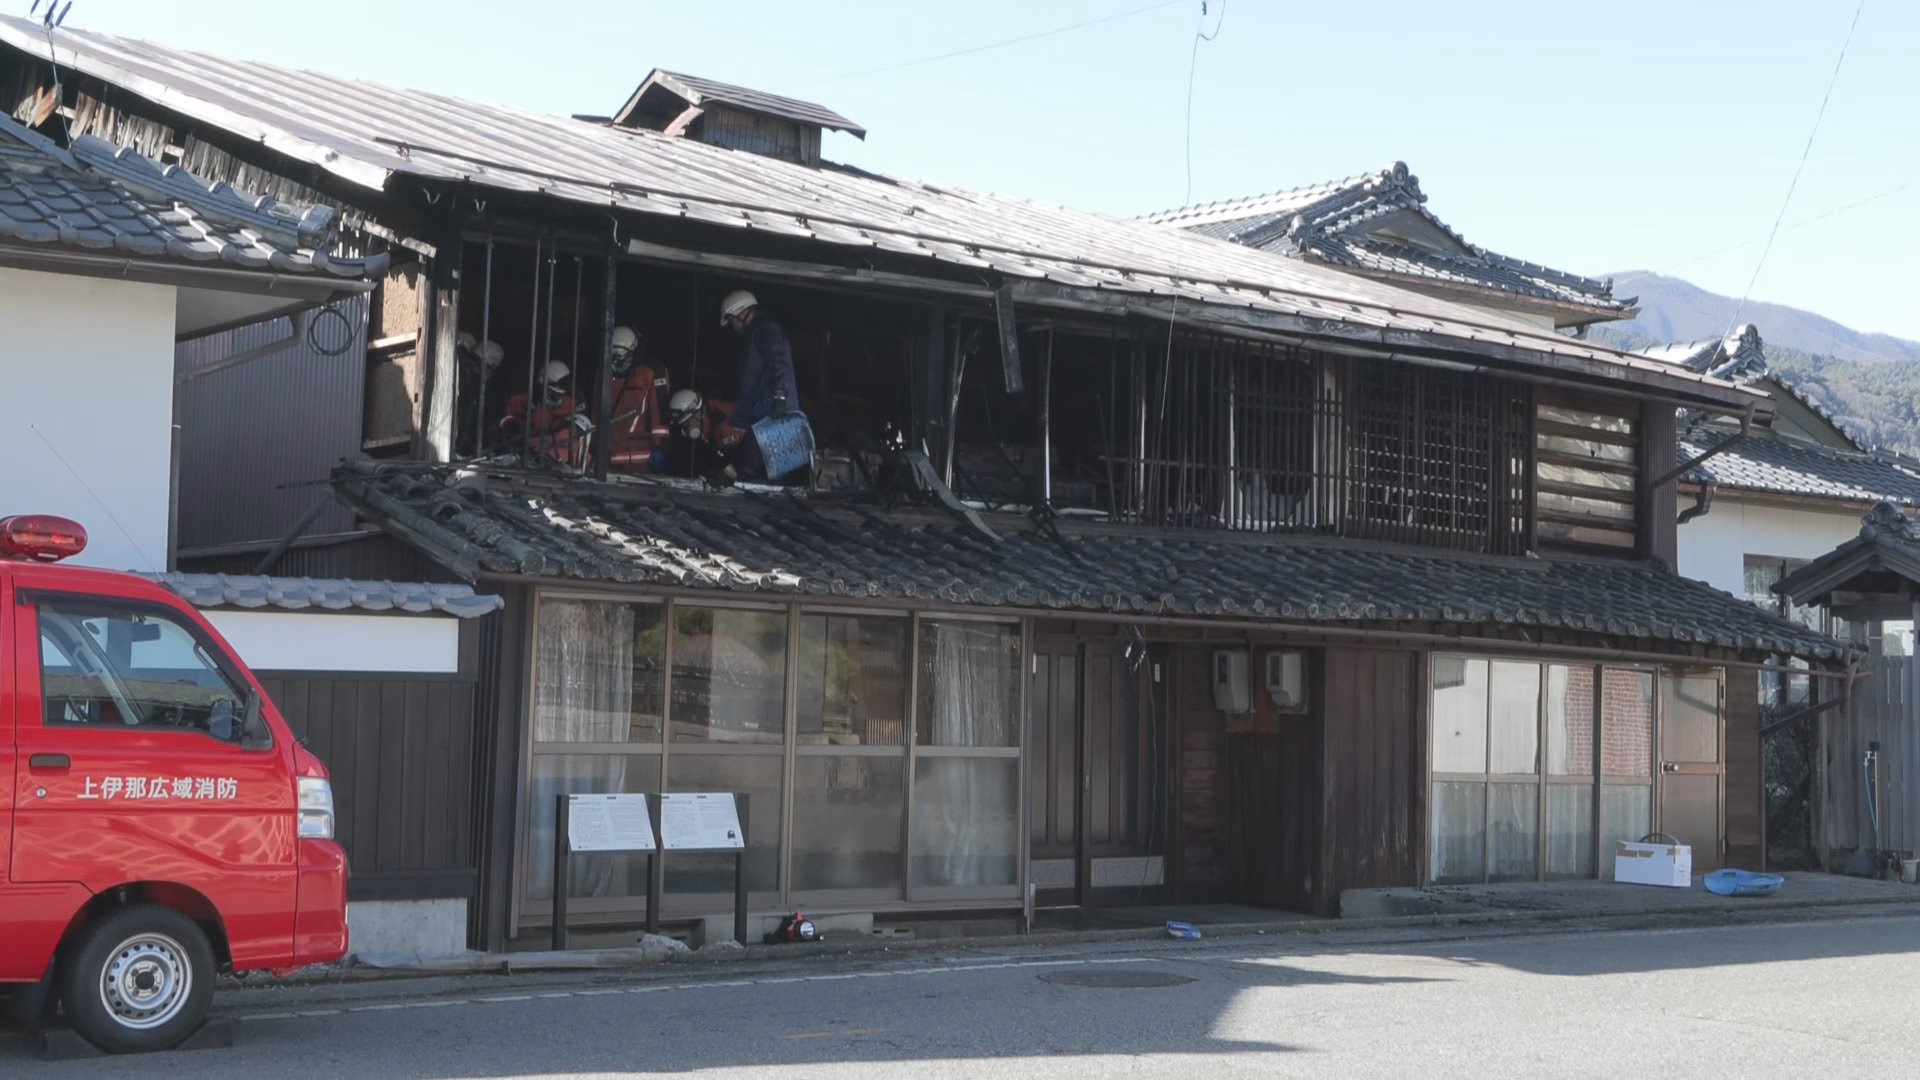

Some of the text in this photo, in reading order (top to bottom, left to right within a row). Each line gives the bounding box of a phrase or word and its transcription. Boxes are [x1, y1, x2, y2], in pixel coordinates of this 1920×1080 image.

[77, 776, 238, 799] 上伊那広域消防
